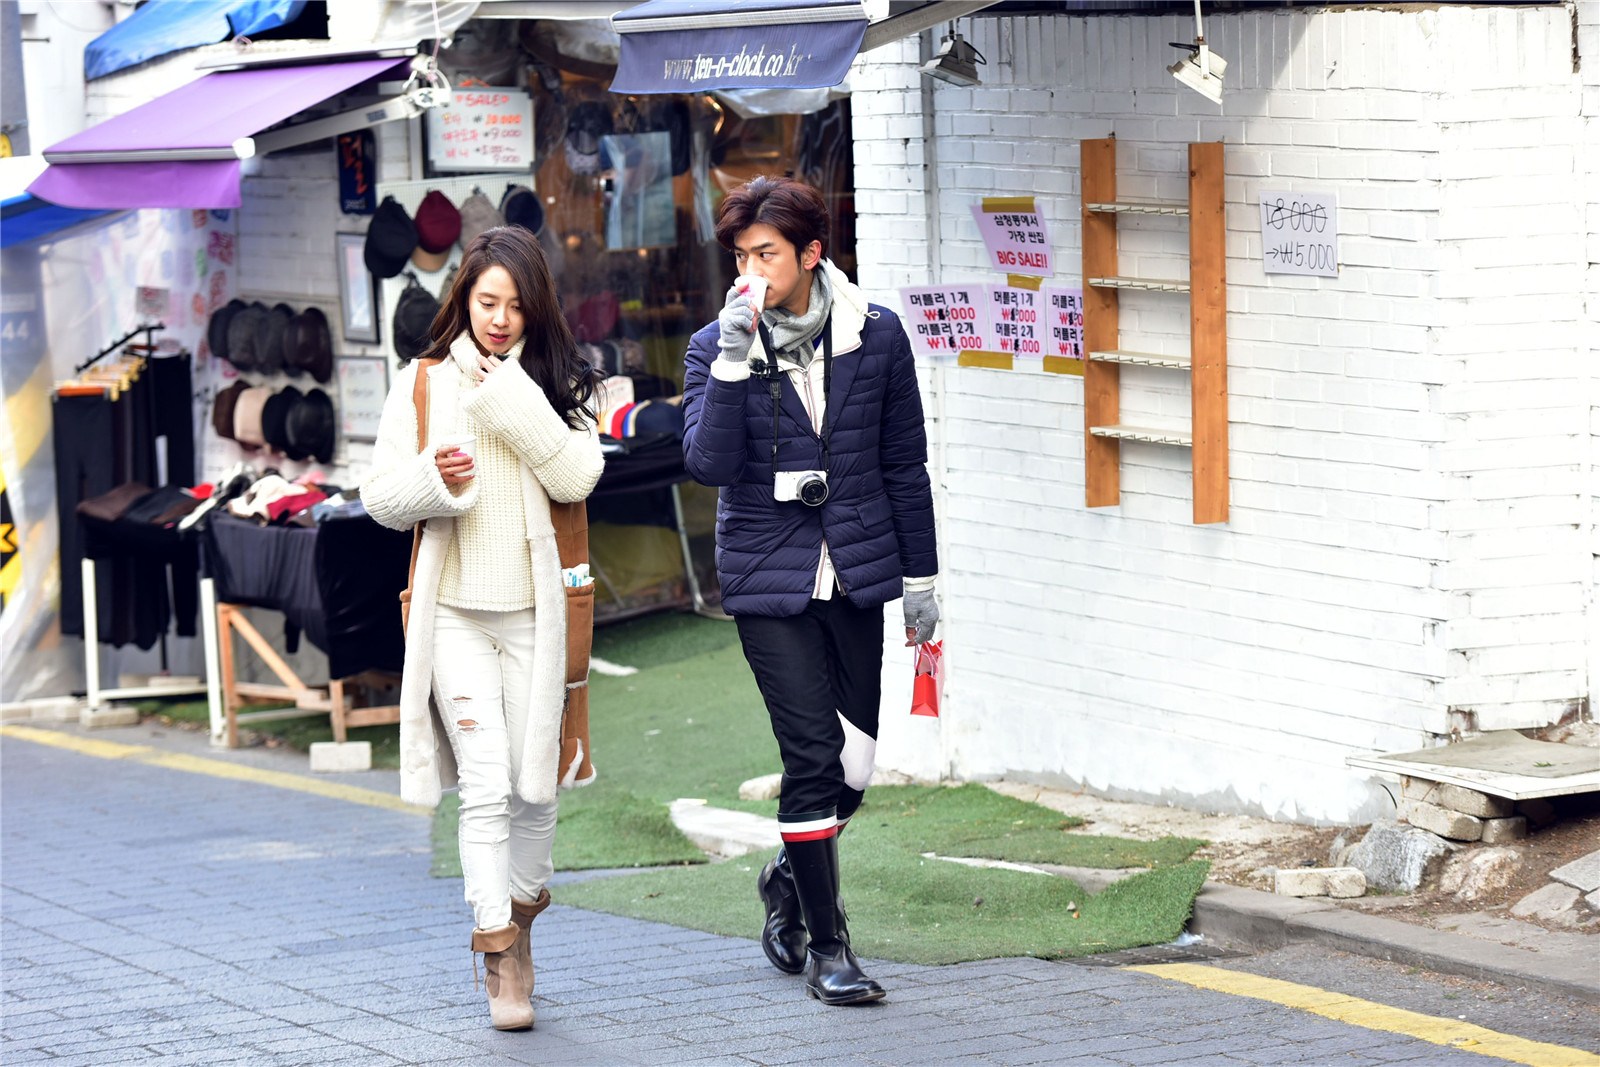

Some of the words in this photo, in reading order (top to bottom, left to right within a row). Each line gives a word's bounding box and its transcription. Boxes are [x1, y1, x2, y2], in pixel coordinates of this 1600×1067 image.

[994, 215, 1039, 227] 삼청동에서
[1008, 230, 1025, 243] 가장
[997, 250, 1016, 265] BIG
[1018, 251, 1048, 268] SALE!!
[910, 292, 946, 306] 머플러
[994, 291, 1018, 305] 머플러
[1052, 295, 1075, 309] 머플러
[917, 323, 952, 336] 머플러
[995, 323, 1018, 337] 머플러
[1053, 327, 1077, 341] 머플러
